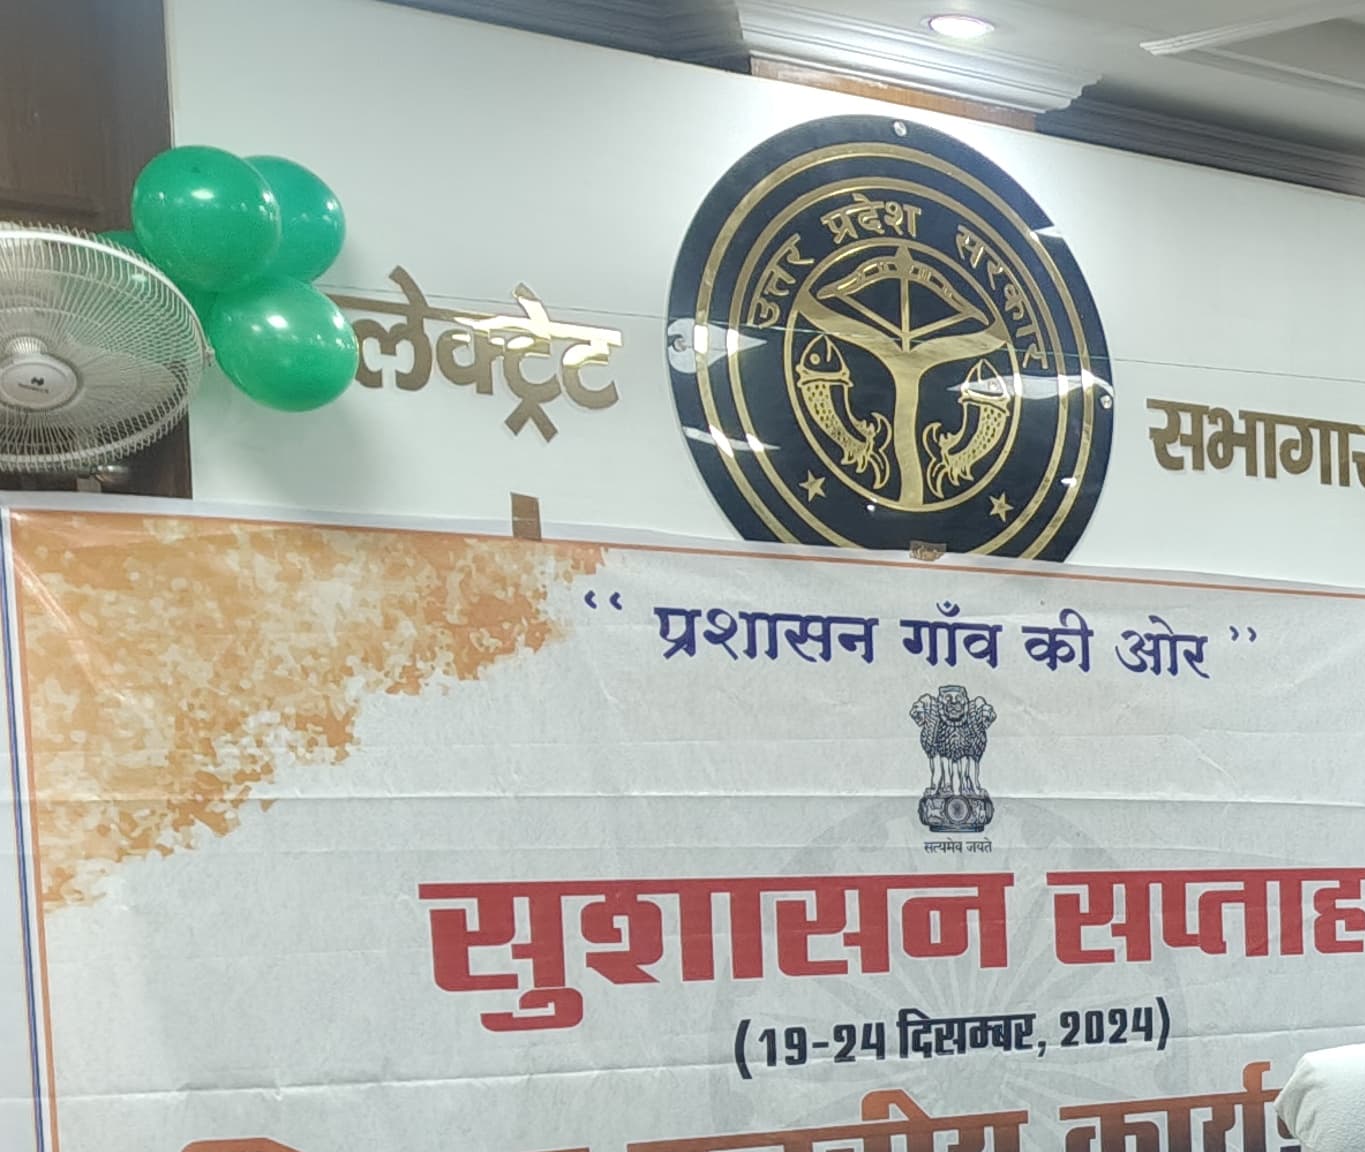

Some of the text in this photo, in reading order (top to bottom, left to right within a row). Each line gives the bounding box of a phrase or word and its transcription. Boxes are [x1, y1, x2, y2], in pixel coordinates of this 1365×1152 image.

[748, 192, 1049, 370] उत्तर प्रदेश सरकार
[326, 265, 622, 443] लेक्ट्रेट
[654, 599, 1211, 680] प्रशासन गाँव की ओर
[923, 836, 993, 854] सत्यमेव जयते
[417, 872, 1014, 1032] सुशासन
[733, 996, 1171, 1080] (19-24 दिसम्बर, 2024)
